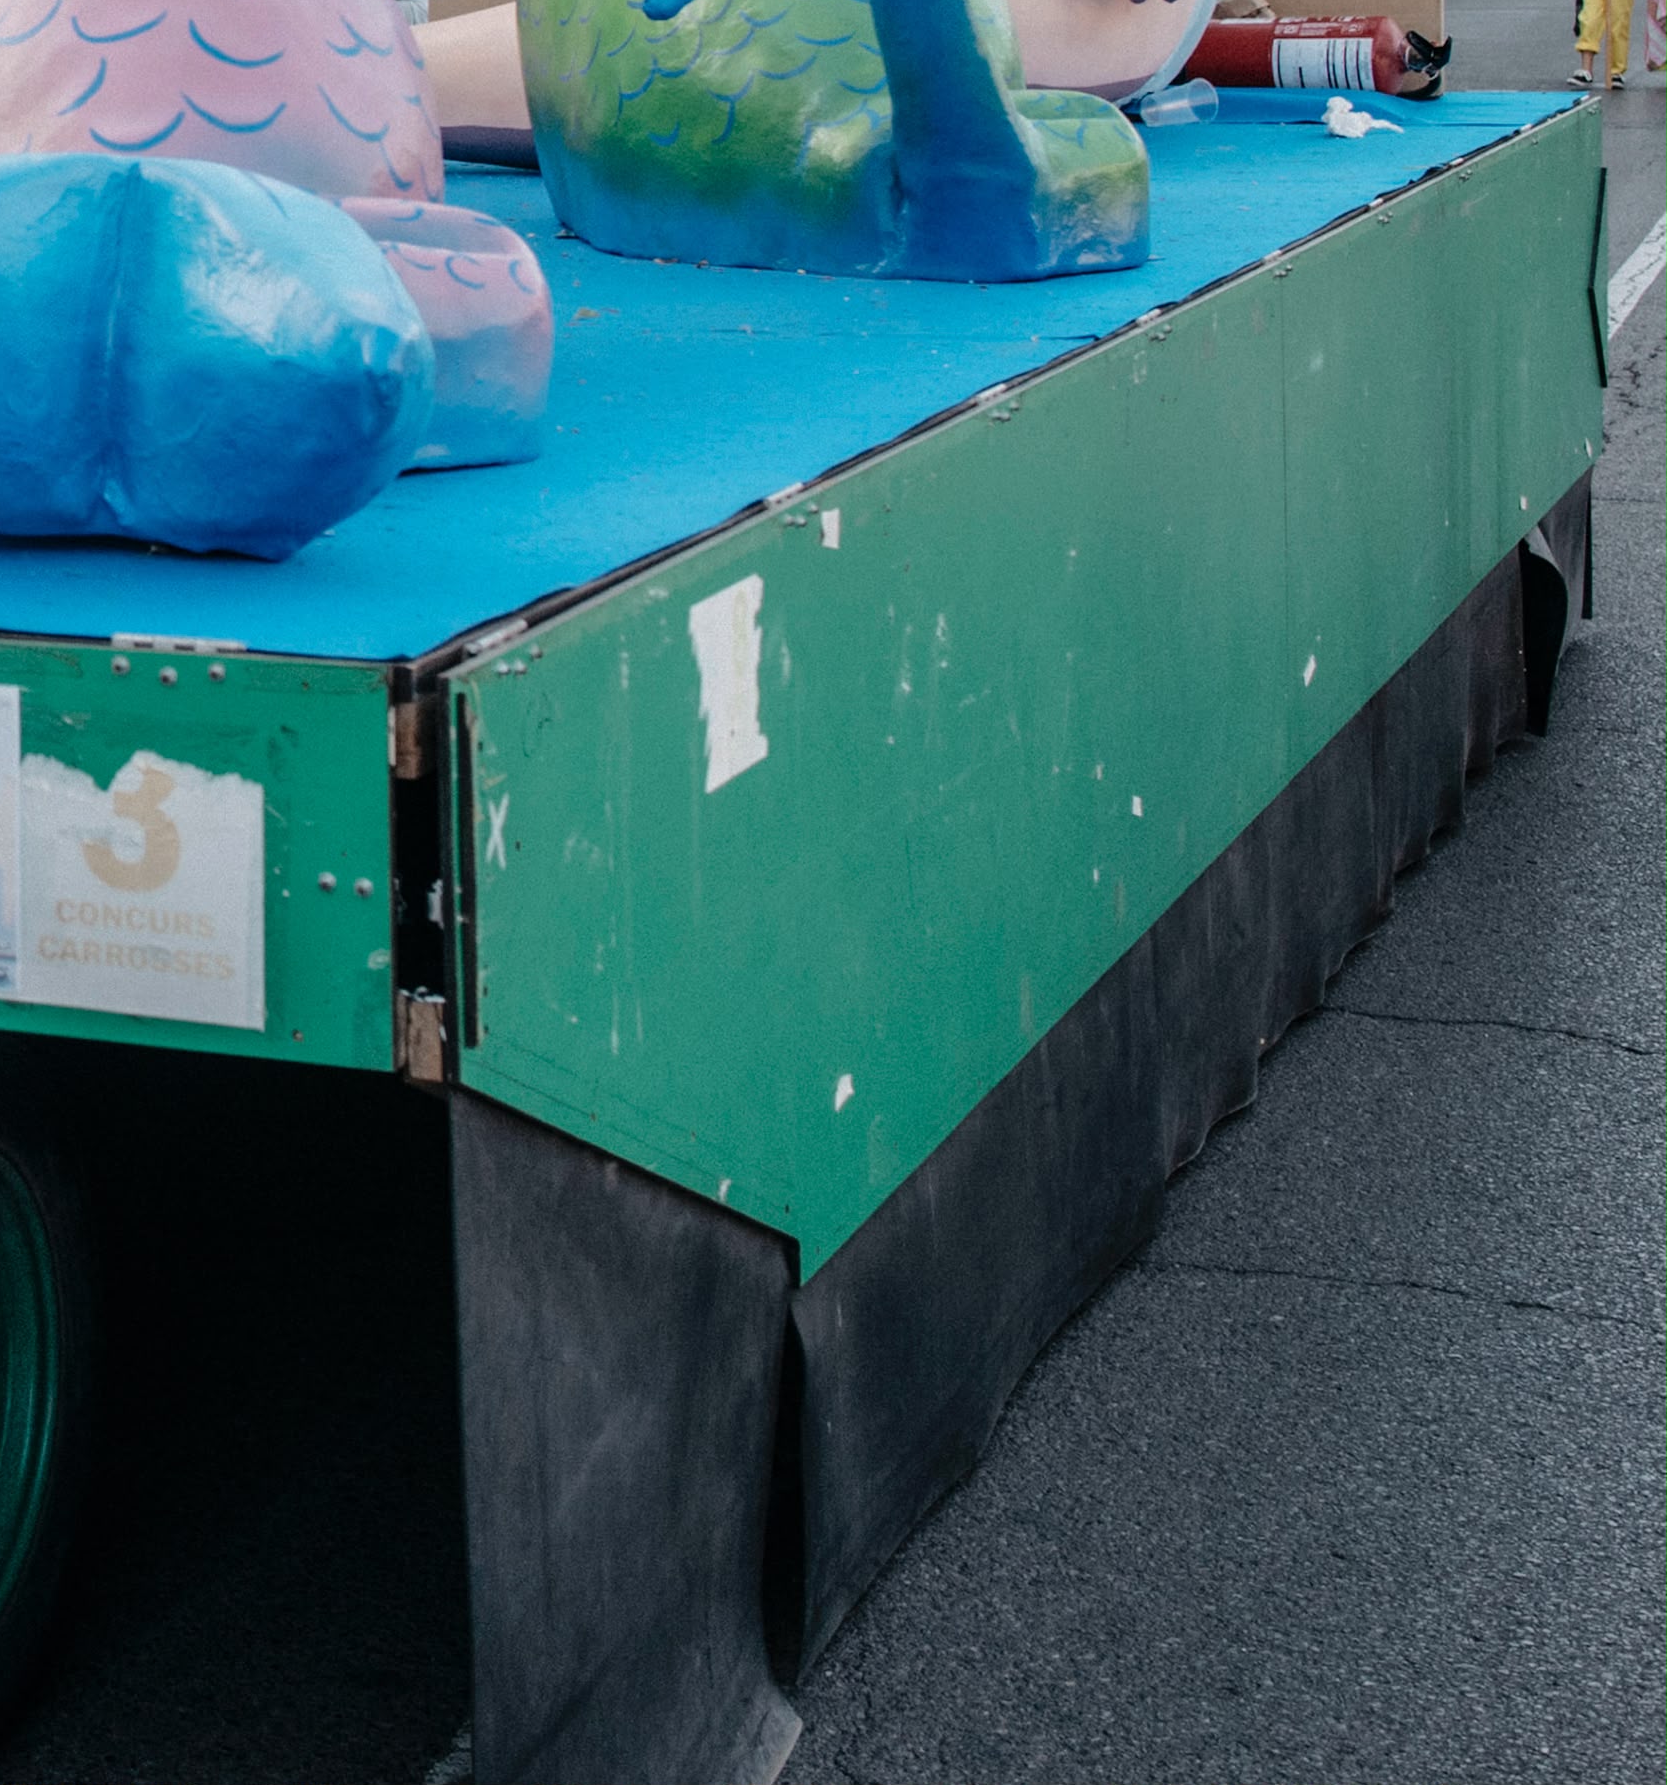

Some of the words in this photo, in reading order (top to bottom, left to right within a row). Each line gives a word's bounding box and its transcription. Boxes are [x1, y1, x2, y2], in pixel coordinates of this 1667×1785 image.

[81, 765, 181, 893] 3
[55, 898, 216, 939] CONCURS
[37, 934, 235, 981] CARROSSES
